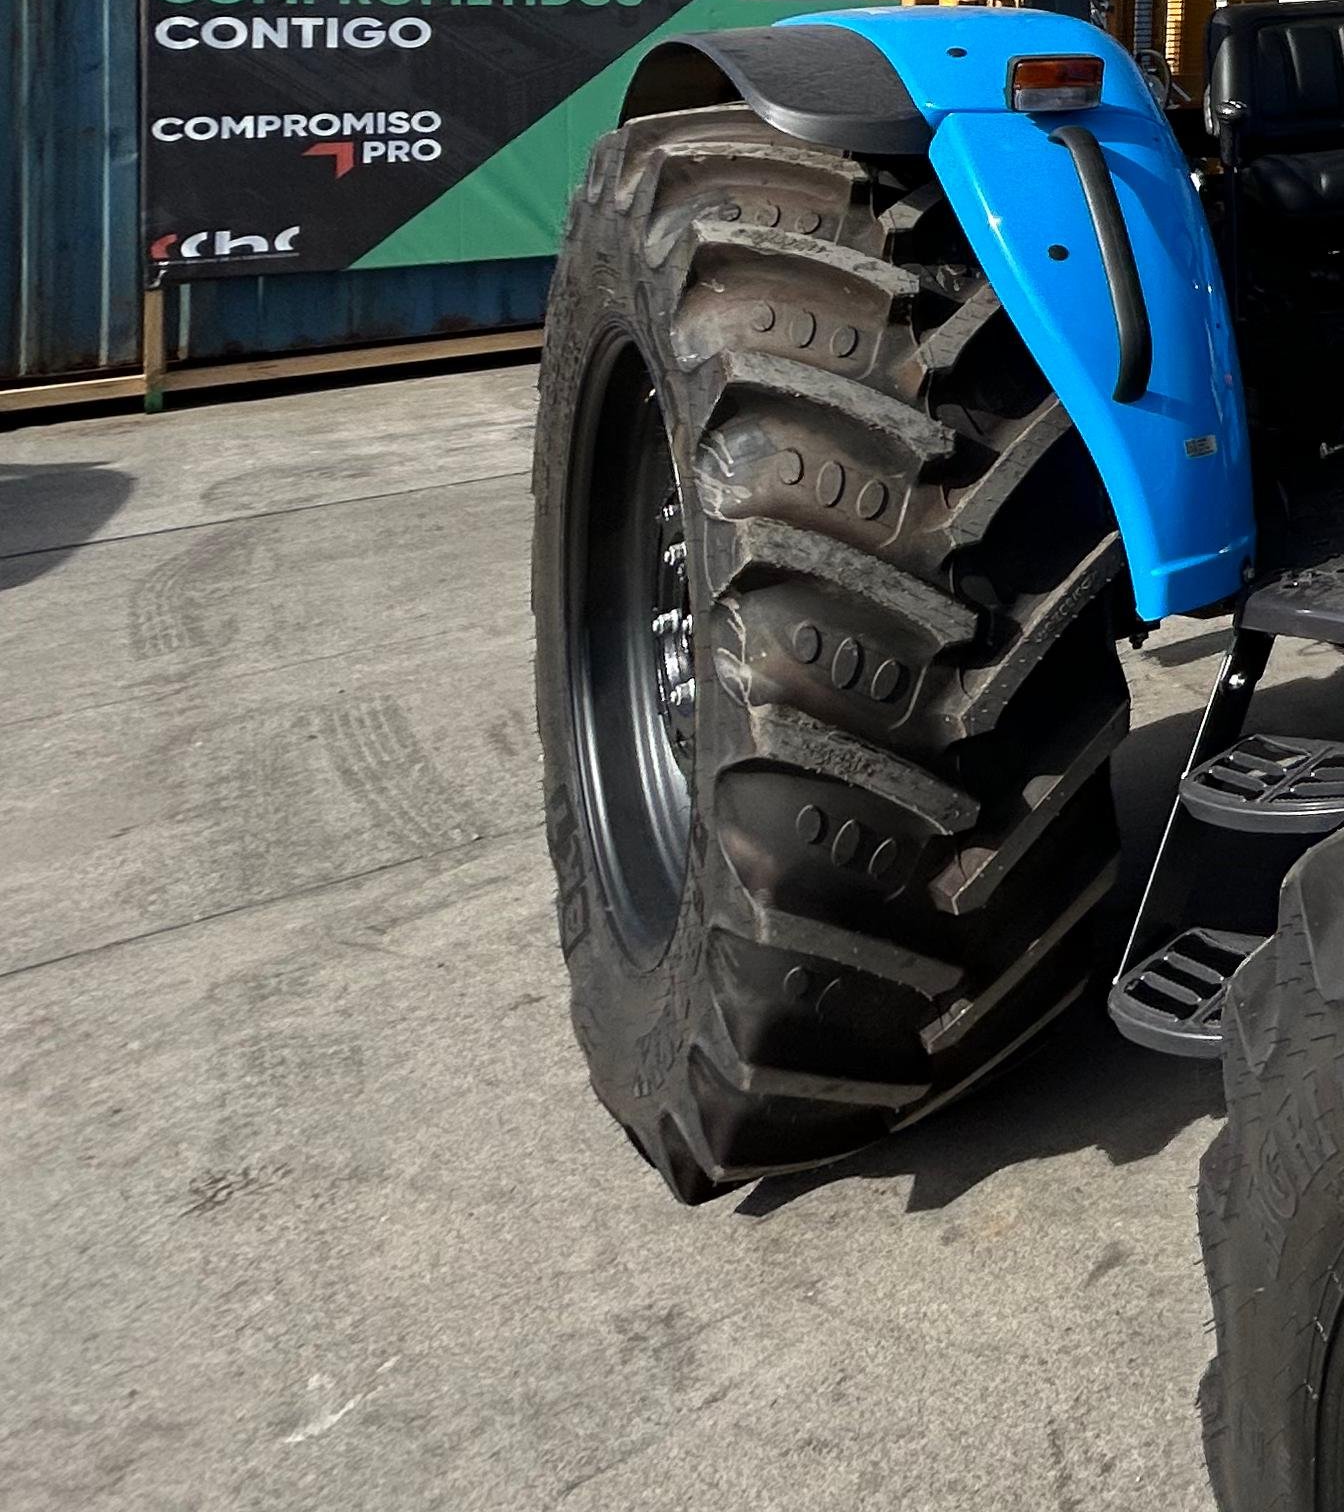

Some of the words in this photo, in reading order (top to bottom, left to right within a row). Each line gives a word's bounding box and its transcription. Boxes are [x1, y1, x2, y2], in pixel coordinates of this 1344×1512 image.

[155, 16, 433, 50] CONTIGO
[152, 110, 442, 142] COMPROMISO
[362, 138, 442, 164] PRO
